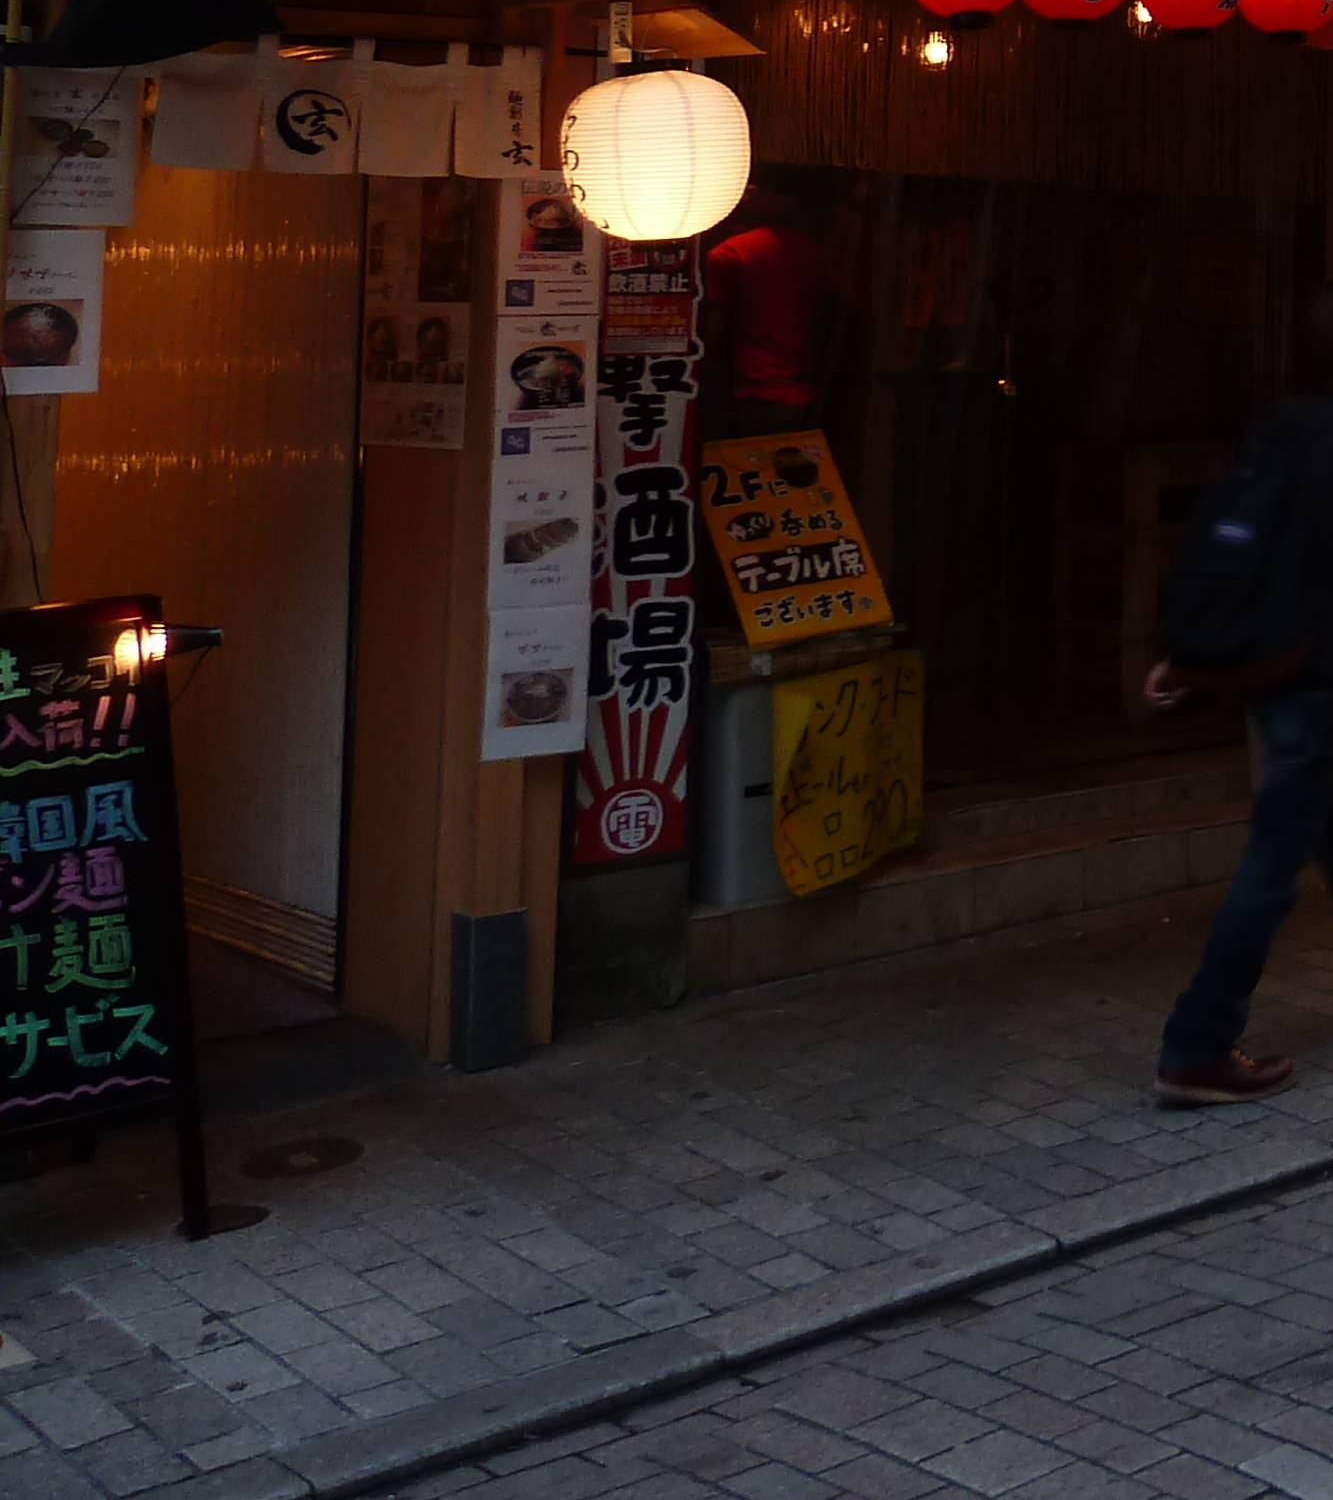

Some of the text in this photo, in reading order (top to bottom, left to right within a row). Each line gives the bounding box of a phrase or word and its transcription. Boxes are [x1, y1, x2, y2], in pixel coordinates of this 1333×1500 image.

[294, 100, 343, 144] 玄
[502, 140, 533, 167] 玄
[733, 540, 864, 593] テーブル席
[610, 796, 656, 849] 電
[0, 995, 168, 1080] サービス
